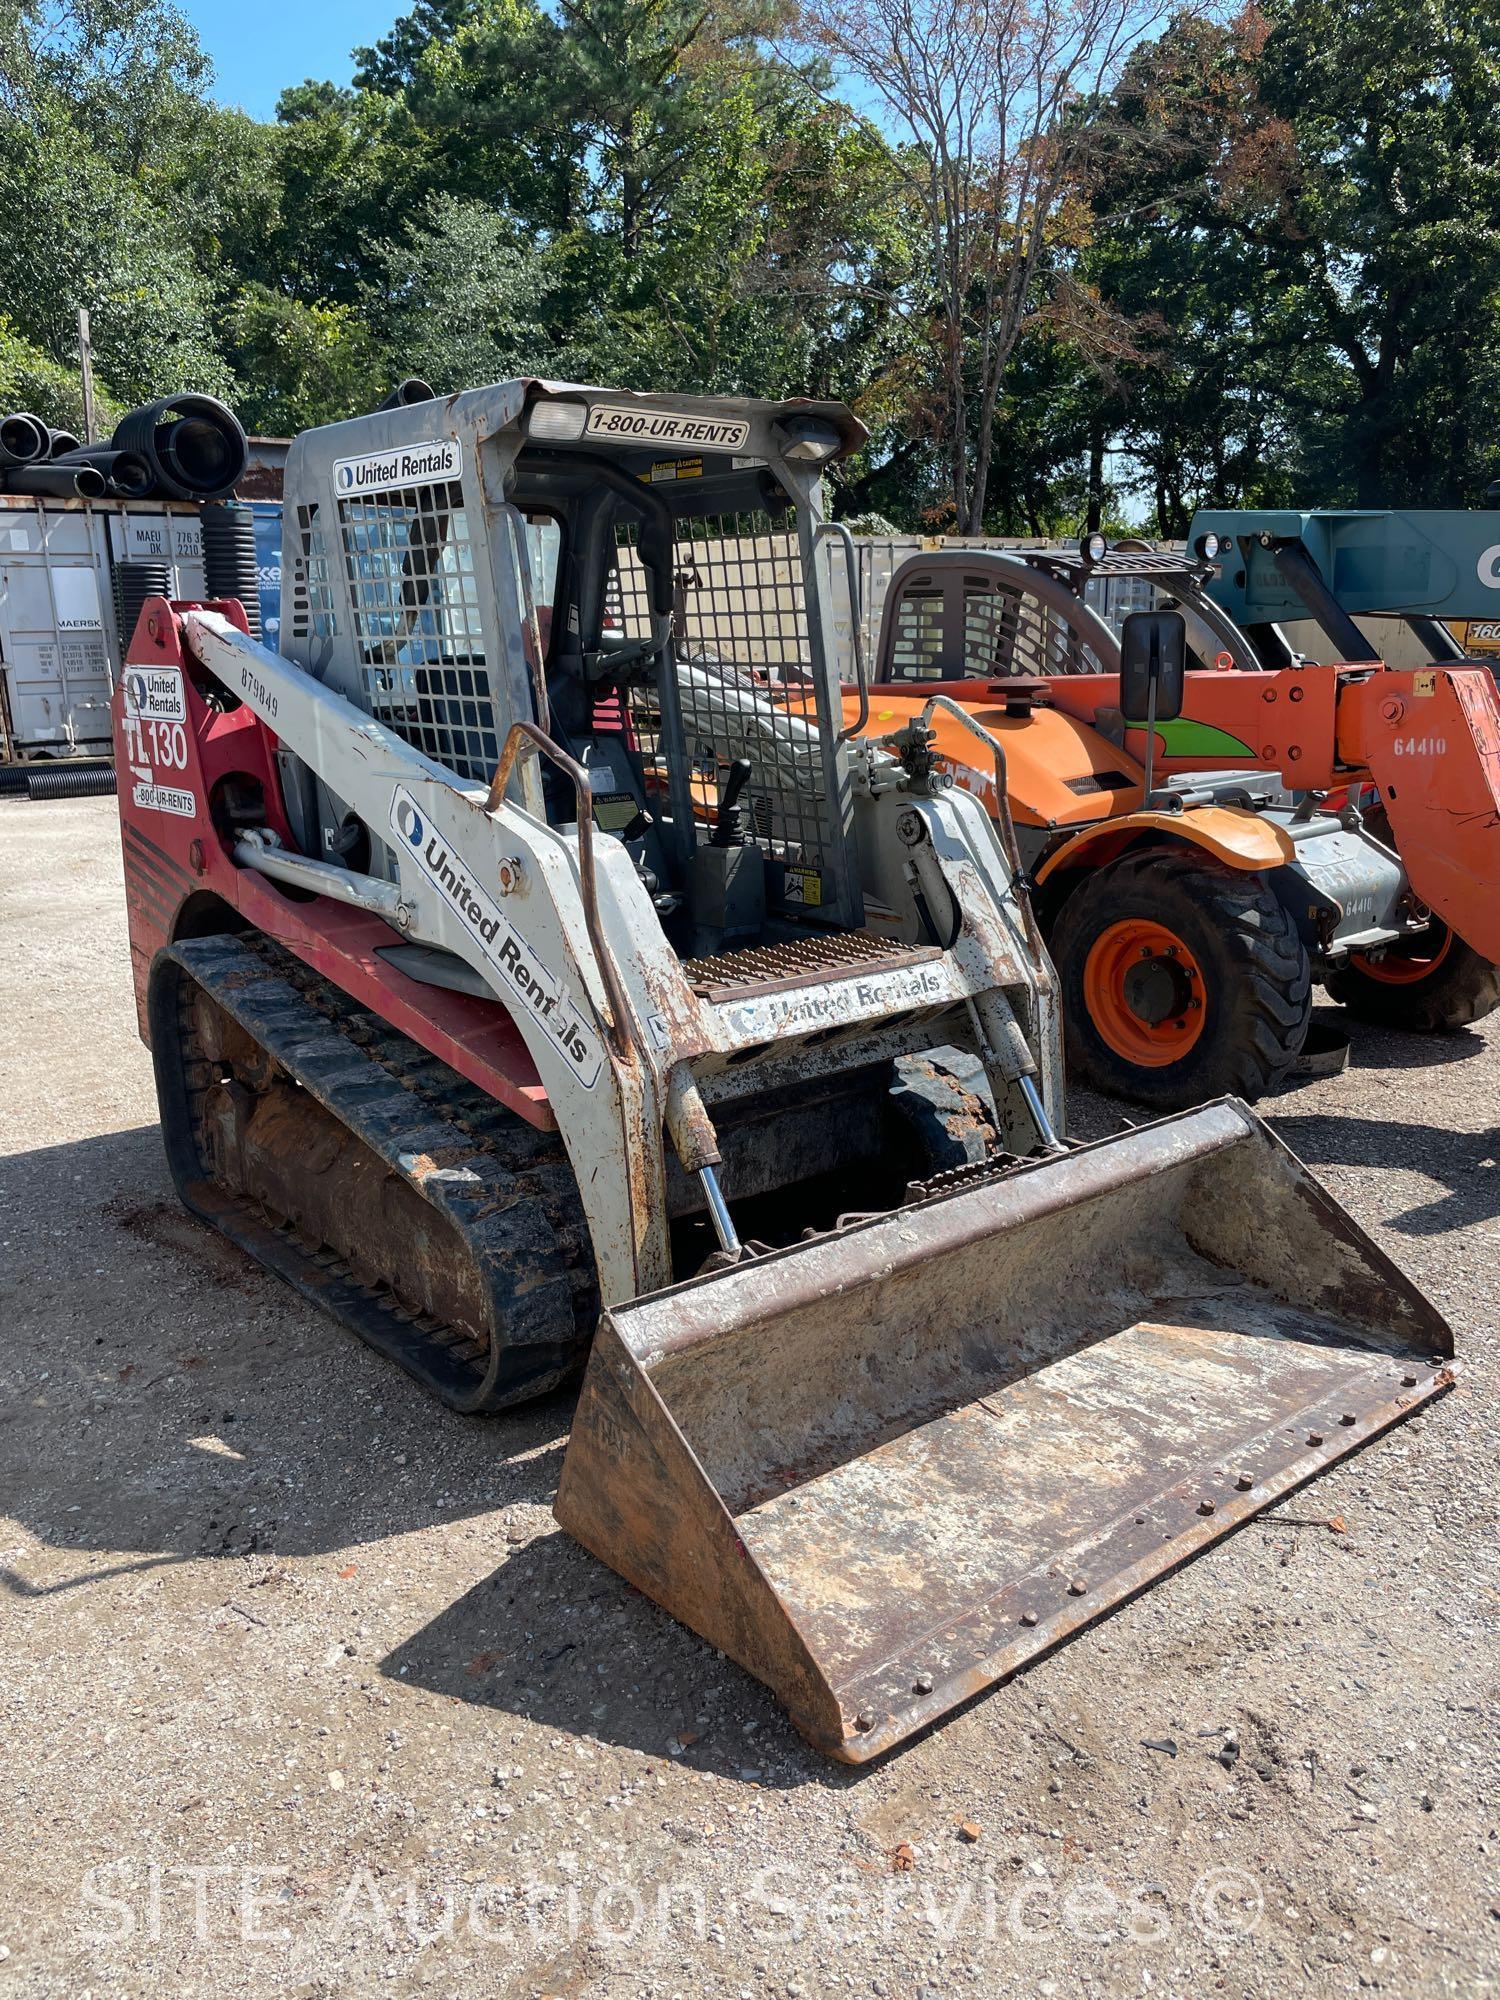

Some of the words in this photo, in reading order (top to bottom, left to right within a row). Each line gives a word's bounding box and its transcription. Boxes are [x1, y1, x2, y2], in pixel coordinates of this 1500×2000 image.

[593, 413, 742, 444] 1-800-UR-RENTS
[356, 458, 398, 485] United
[401, 448, 452, 477] Rentals
[136, 530, 161, 542] MAEU
[150, 543, 162, 554] DK
[178, 544, 198, 556] 2210
[57, 620, 101, 628] MAERSK
[147, 675, 176, 694] United
[241, 667, 278, 718] 879849
[149, 694, 181, 713] Rentals
[1394, 737, 1446, 756] 64410
[423, 837, 500, 944] United
